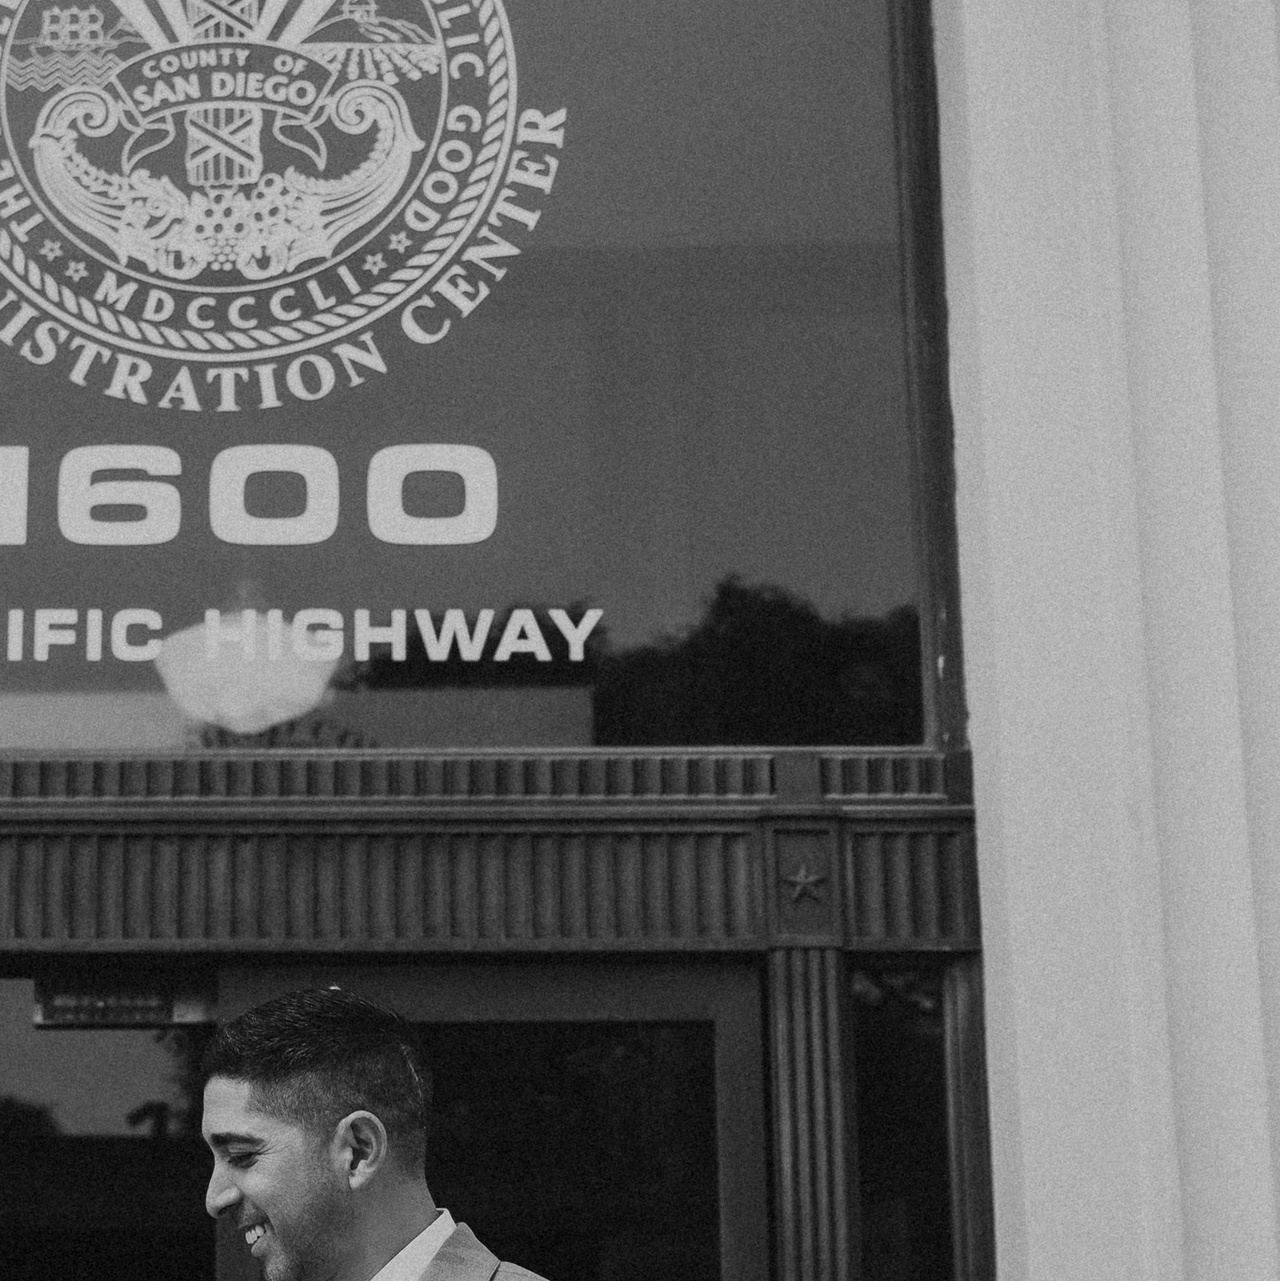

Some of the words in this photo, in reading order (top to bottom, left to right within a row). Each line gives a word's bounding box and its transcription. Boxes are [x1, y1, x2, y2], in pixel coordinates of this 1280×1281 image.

[141, 47, 251, 79] COUNTY
[273, 54, 308, 76] OF
[132, 73, 202, 112] SAN
[210, 71, 317, 107] DIEGO
[403, 104, 482, 232] GOOD
[400, 106, 568, 345] CENTER
[204, 608, 605, 663] HIGHWAY
